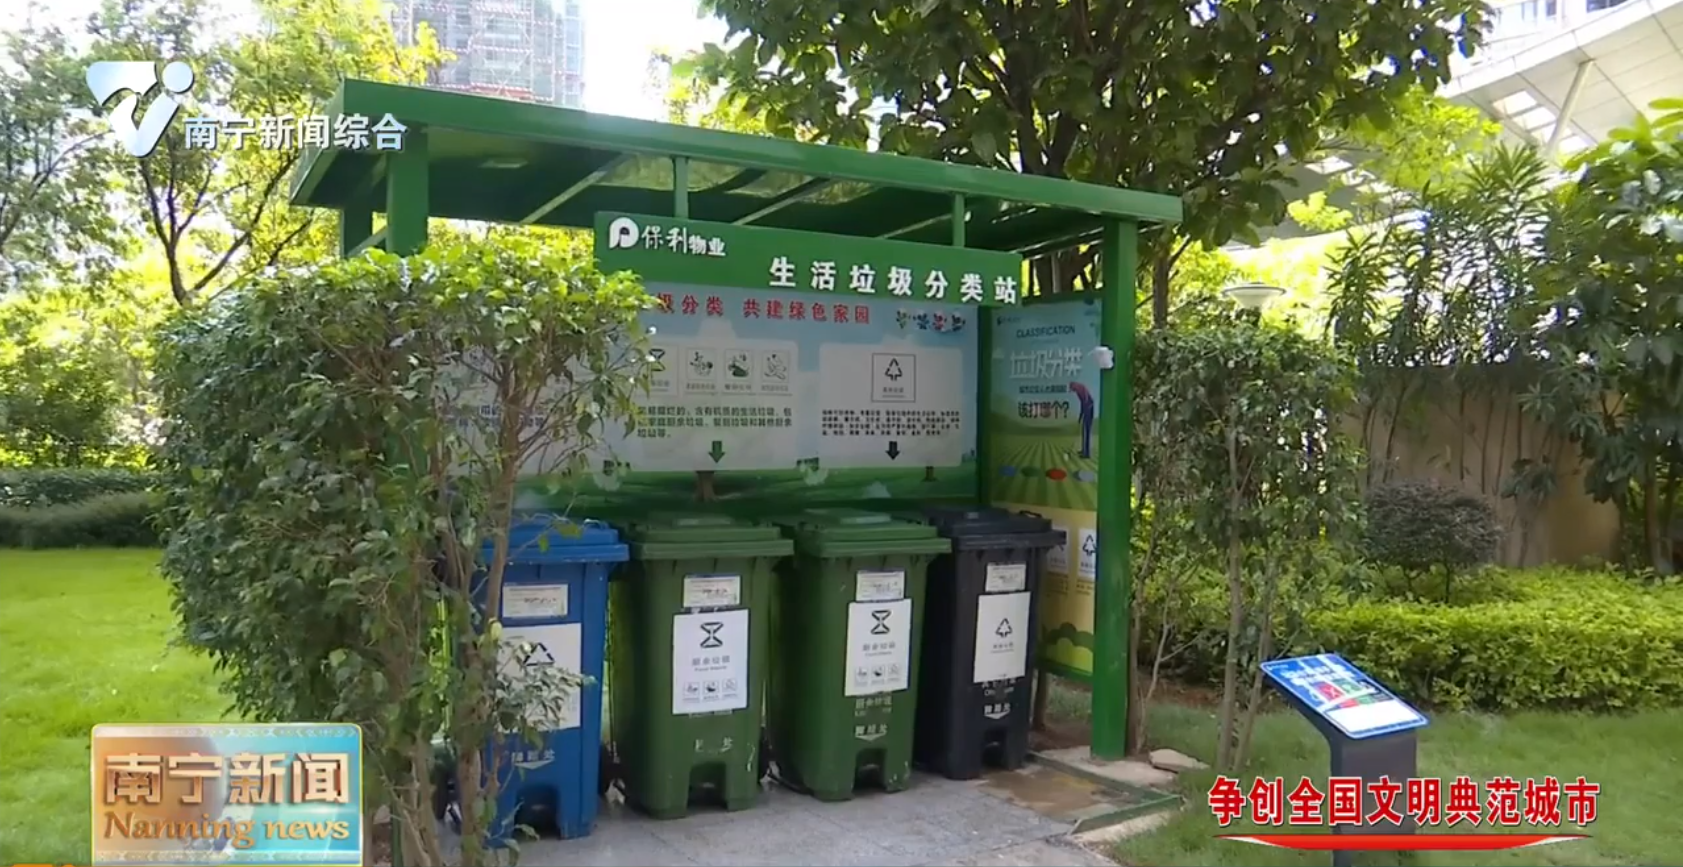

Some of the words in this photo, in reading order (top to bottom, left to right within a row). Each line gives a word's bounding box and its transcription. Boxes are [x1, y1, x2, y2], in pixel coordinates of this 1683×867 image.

[642, 226, 726, 258] 保利物业
[769, 257, 1018, 304] 生活垃圾分类站
[743, 298, 871, 324] 共建绿色家园
[1016, 325, 1076, 338] CLASSIFICATION
